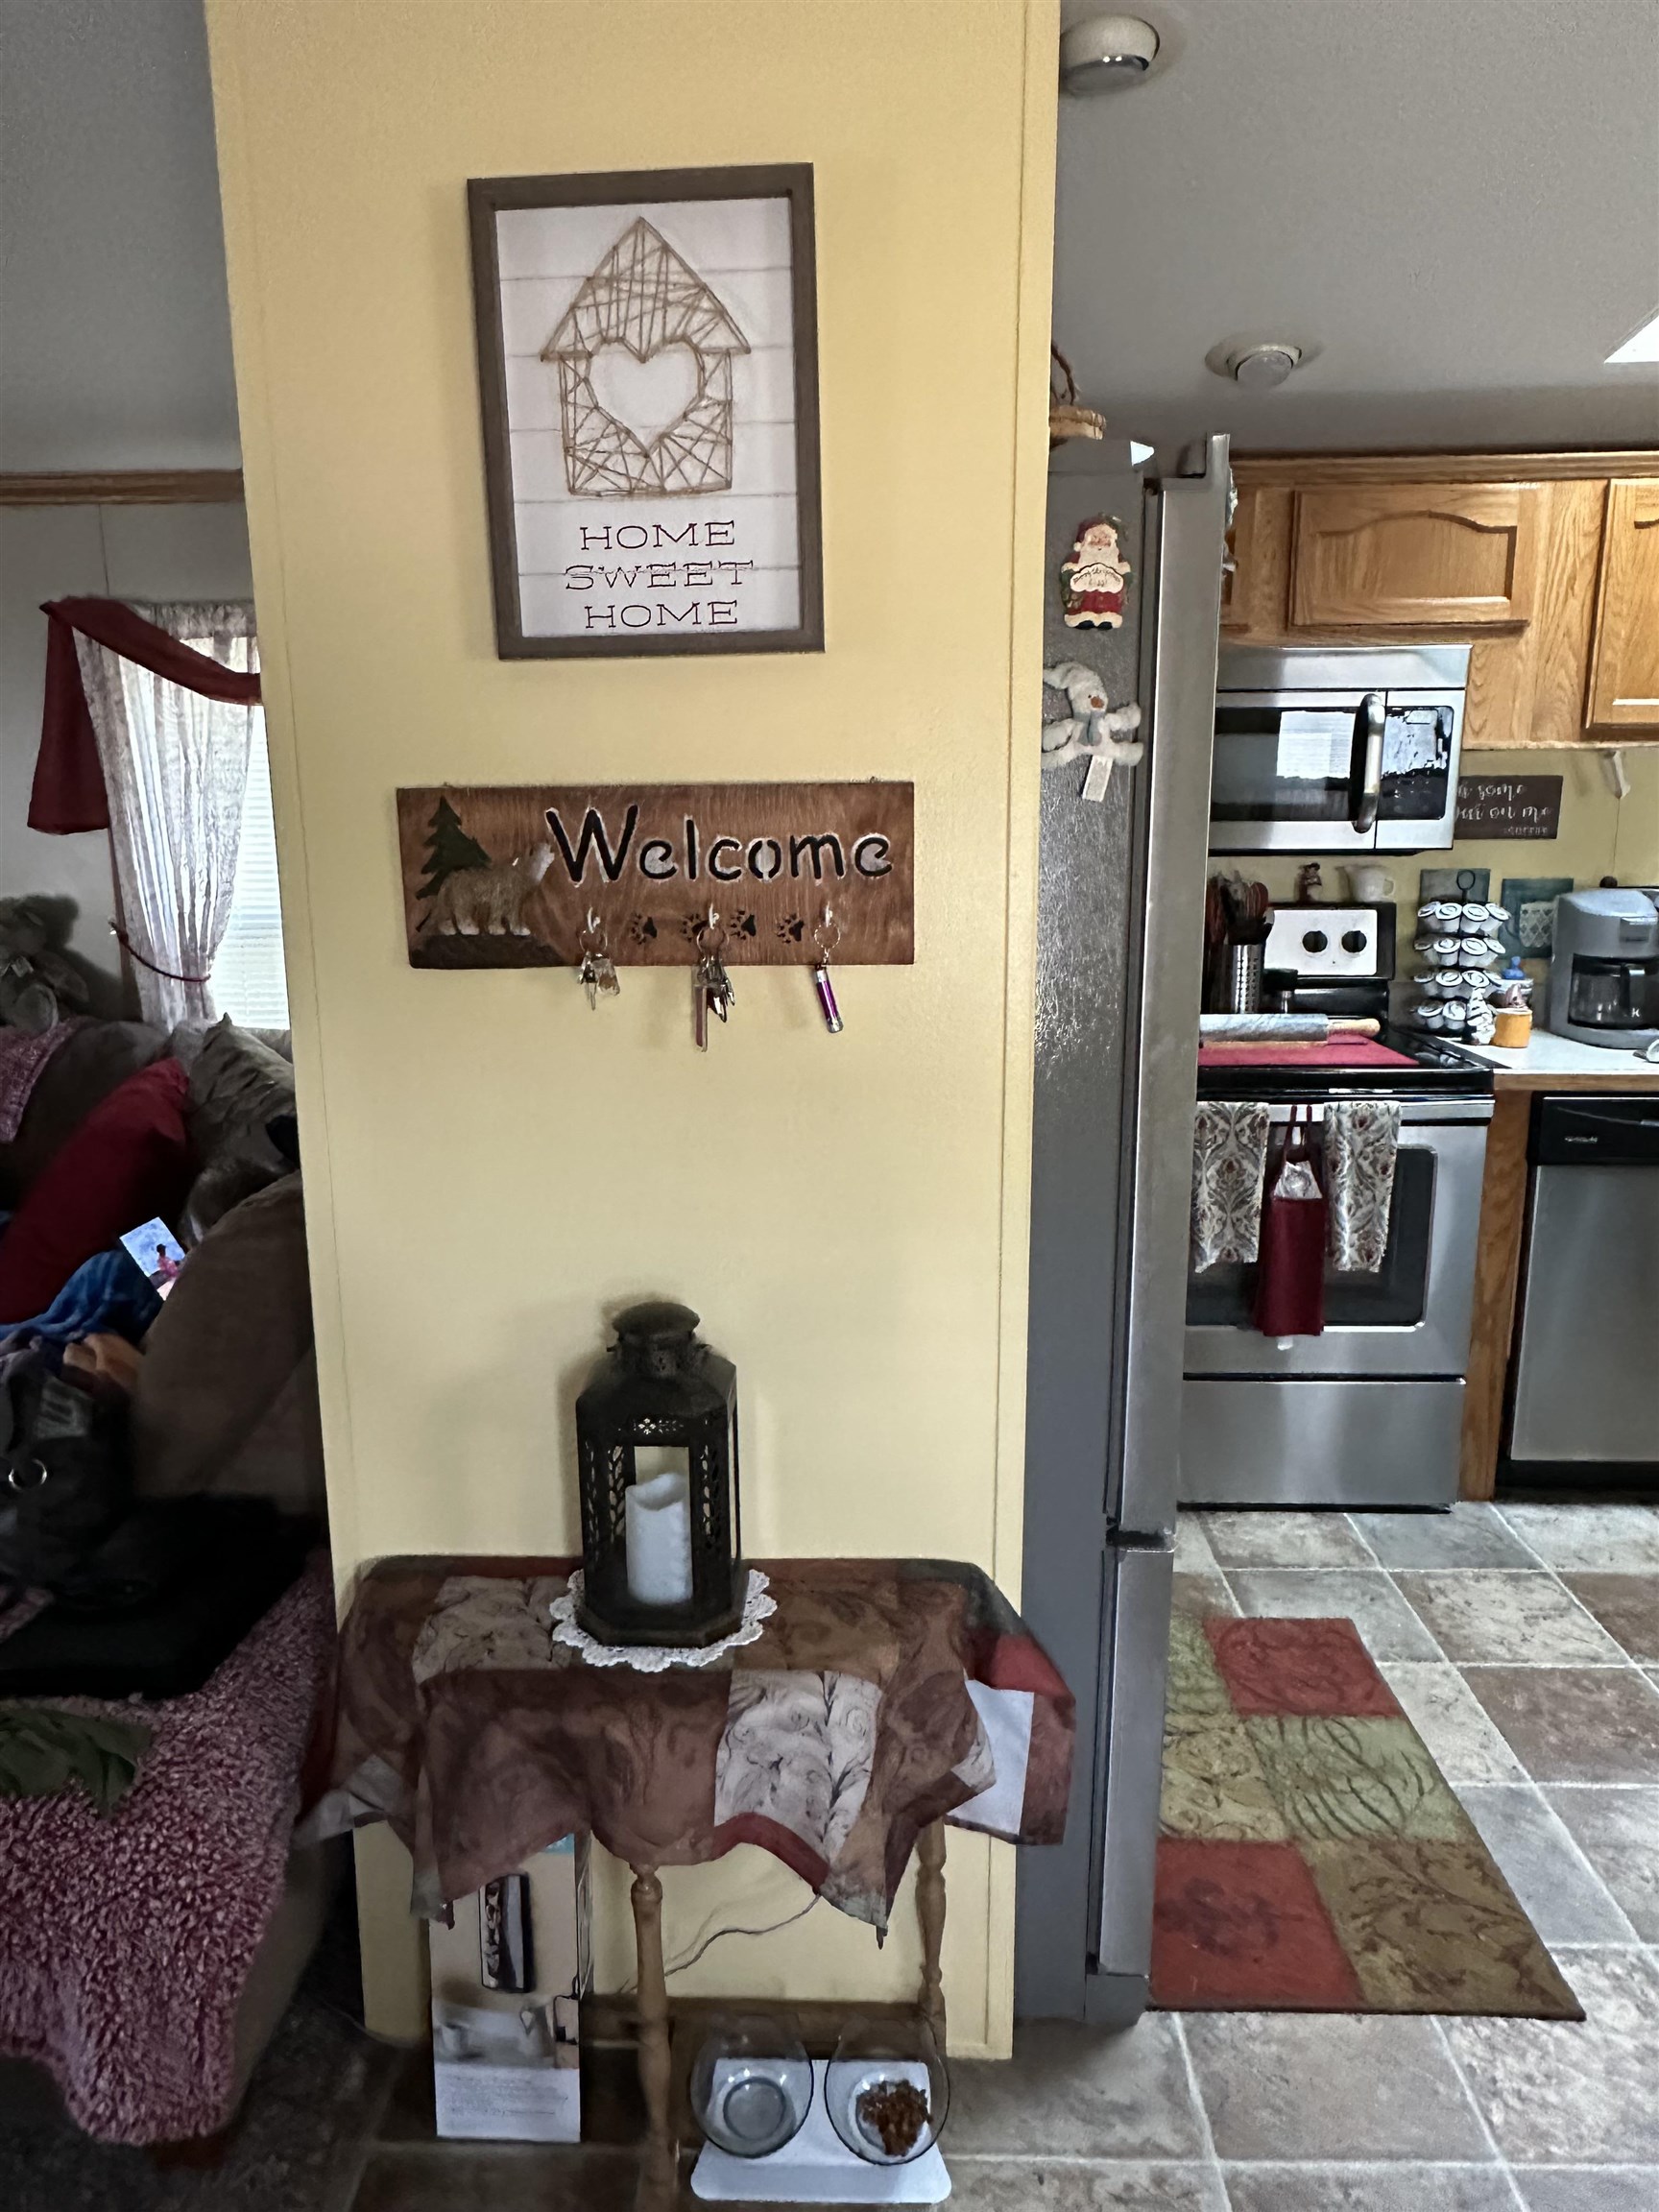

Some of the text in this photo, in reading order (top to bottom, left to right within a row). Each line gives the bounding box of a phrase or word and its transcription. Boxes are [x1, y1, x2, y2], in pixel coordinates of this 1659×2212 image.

[579, 520, 735, 550] HOME
[565, 560, 754, 590] SWEET
[584, 600, 738, 629] HOME
[545, 805, 893, 883] Welcome
